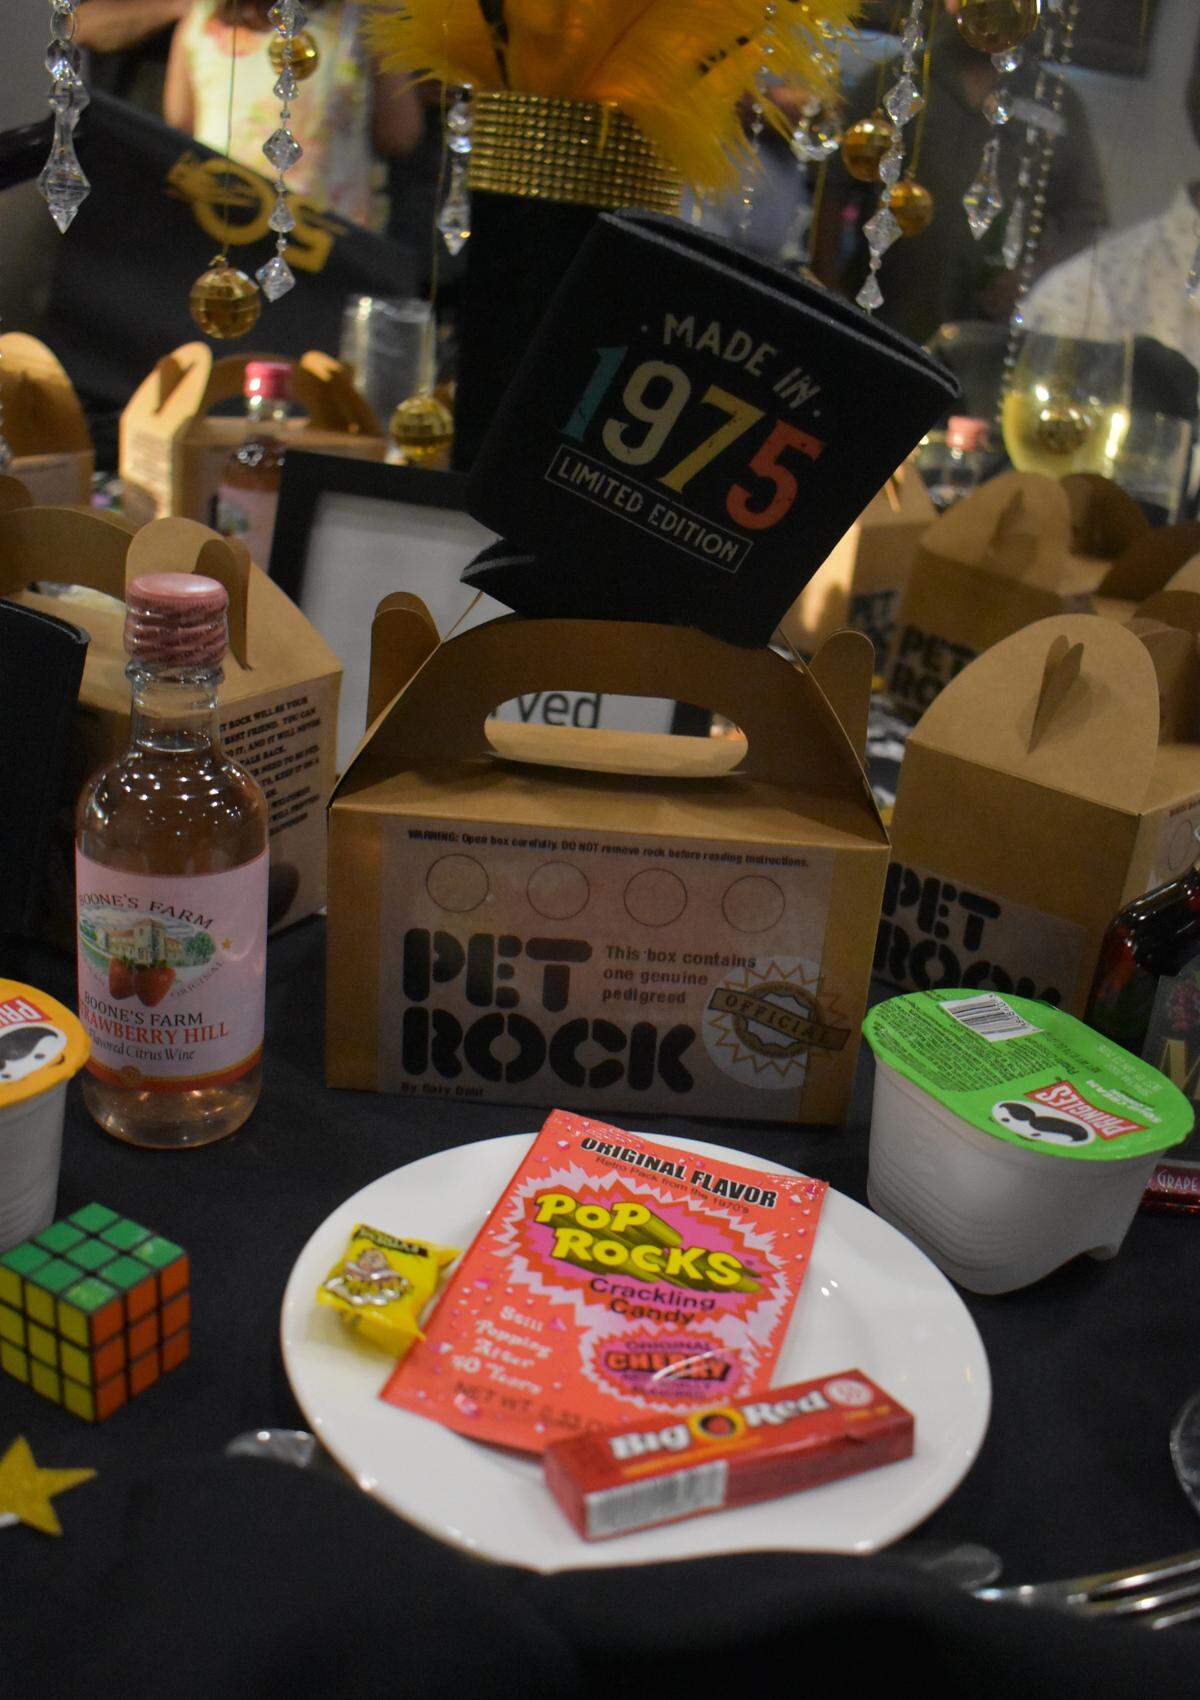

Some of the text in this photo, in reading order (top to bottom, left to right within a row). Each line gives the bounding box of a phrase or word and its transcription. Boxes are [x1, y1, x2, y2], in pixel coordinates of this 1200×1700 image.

[663, 312, 822, 410] MADE IN
[559, 346, 826, 530] 1975
[557, 456, 739, 563] LIMITED EDITION
[462, 833, 487, 845] Open
[490, 834, 509, 846] box
[561, 841, 576, 851] DO
[579, 843, 599, 853] NOT
[602, 845, 640, 856] remove
[643, 846, 665, 857] rock
[669, 849, 700, 859] before
[703, 851, 742, 865] reading
[150, 901, 214, 930] FARM
[402, 928, 593, 1012] PET
[603, 968, 708, 986] one genuine
[606, 945, 757, 969] This box contains
[85, 991, 203, 1027] BOONE'S FARM
[602, 987, 686, 1005] pedigreed
[184, 1021, 229, 1044] HILL
[726, 994, 830, 1044] OFFICIAL
[127, 1044, 161, 1062] Citrus
[165, 1048, 197, 1061] Wine
[401, 1006, 696, 1093] ROCK
[1034, 1084, 1139, 1137] PRINGLES
[581, 1137, 778, 1208] ORIGINAL FLAVOR
[630, 1167, 658, 1182] Pack
[662, 1178, 688, 1193] from
[690, 1187, 708, 1201] the
[714, 1196, 750, 1214] 1970's
[1157, 1169, 1198, 1192] GRAPE
[552, 1228, 743, 1286] ROCKS
[590, 1278, 716, 1310] Crackling
[610, 1298, 695, 1325] Candy
[475, 1319, 553, 1359] Popping
[609, 1424, 692, 1460] Big
[740, 1390, 830, 1428] Red
